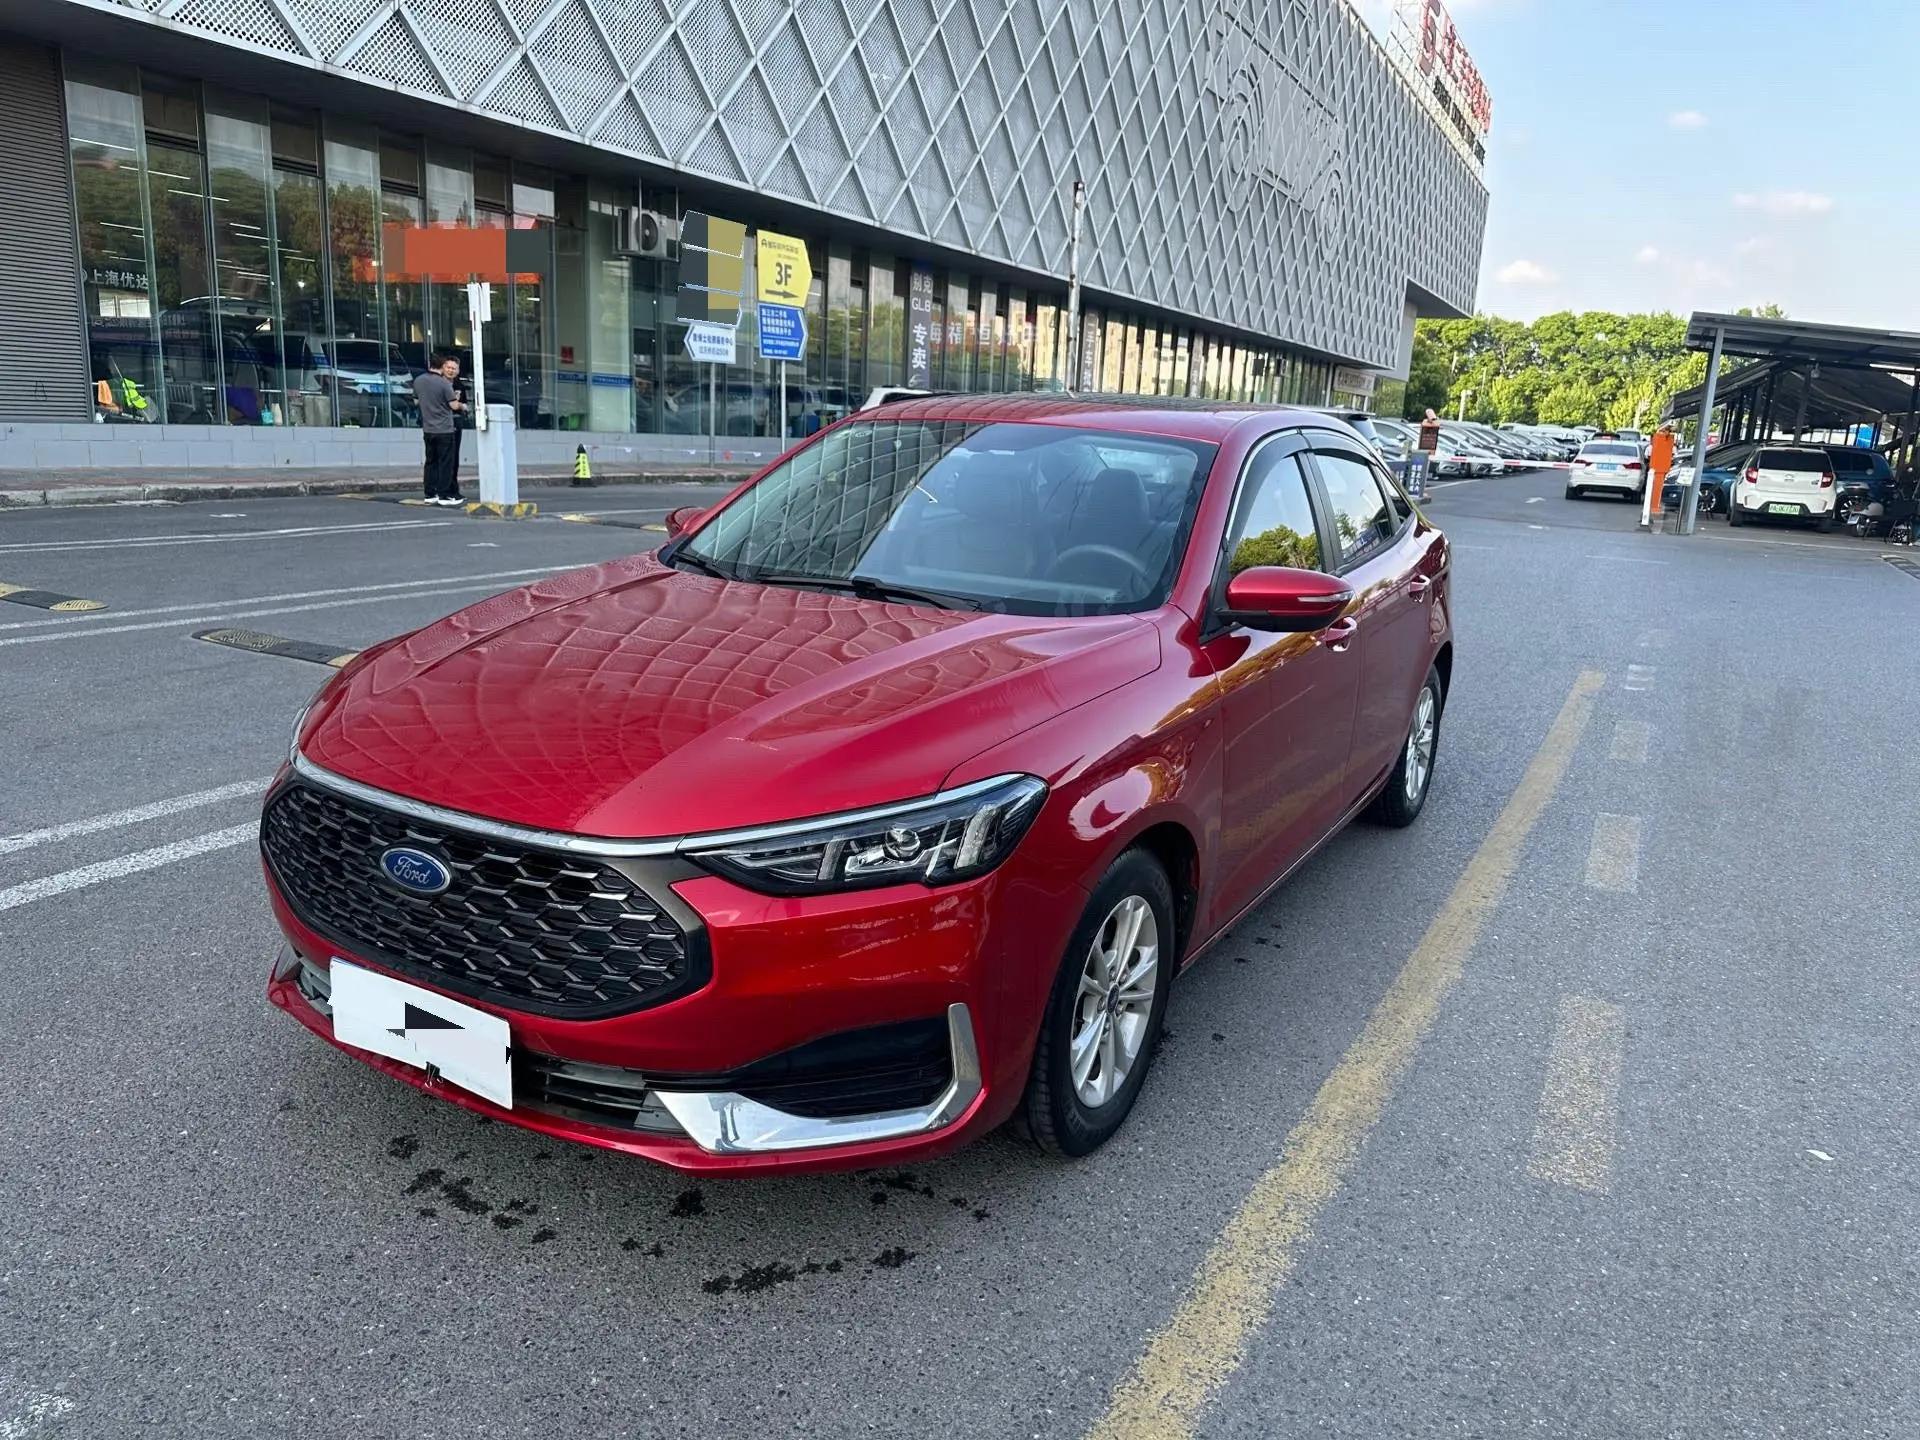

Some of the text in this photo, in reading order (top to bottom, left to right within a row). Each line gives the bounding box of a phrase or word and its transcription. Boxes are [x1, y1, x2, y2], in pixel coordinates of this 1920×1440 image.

[89, 268, 149, 289] 上海优达
[775, 262, 792, 286] 3F
[912, 273, 933, 297] 别克
[911, 323, 928, 370] 专卖
[393, 856, 431, 884] Ford
